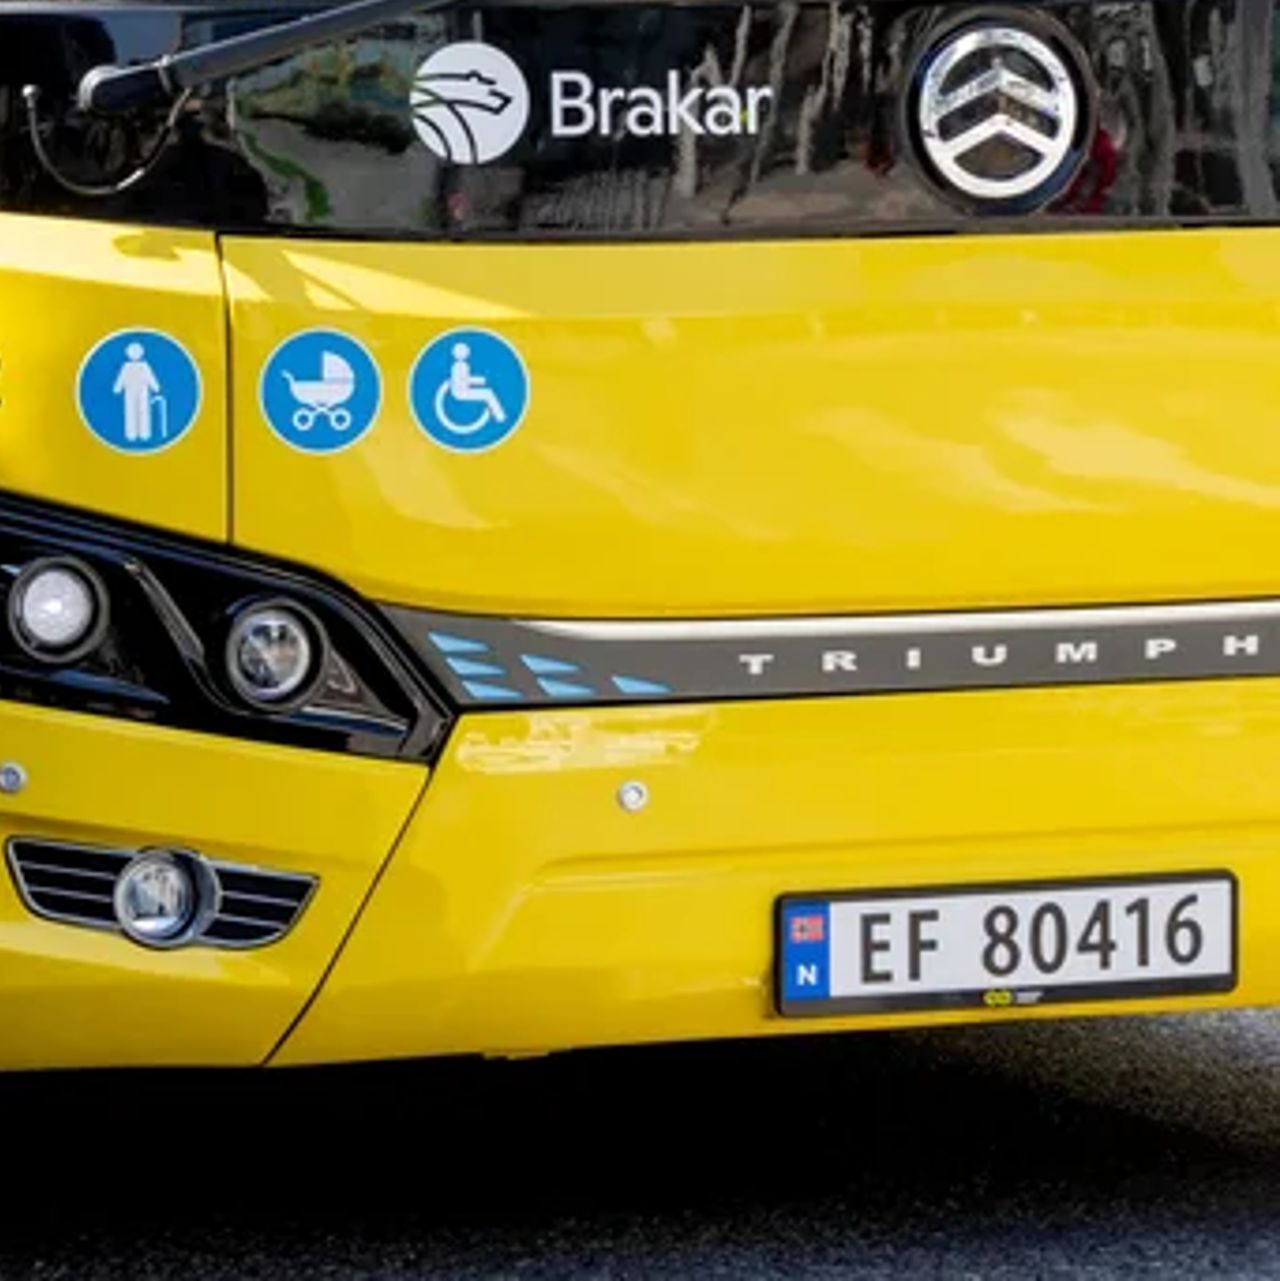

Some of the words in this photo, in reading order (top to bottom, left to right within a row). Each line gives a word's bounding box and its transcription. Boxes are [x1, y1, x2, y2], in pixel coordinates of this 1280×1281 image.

[550, 69, 773, 137] Brakar
[739, 634, 1260, 676] TRIUMPH
[859, 908, 940, 985] EF
[981, 893, 1205, 978] 80416
[796, 963, 818, 986] N
